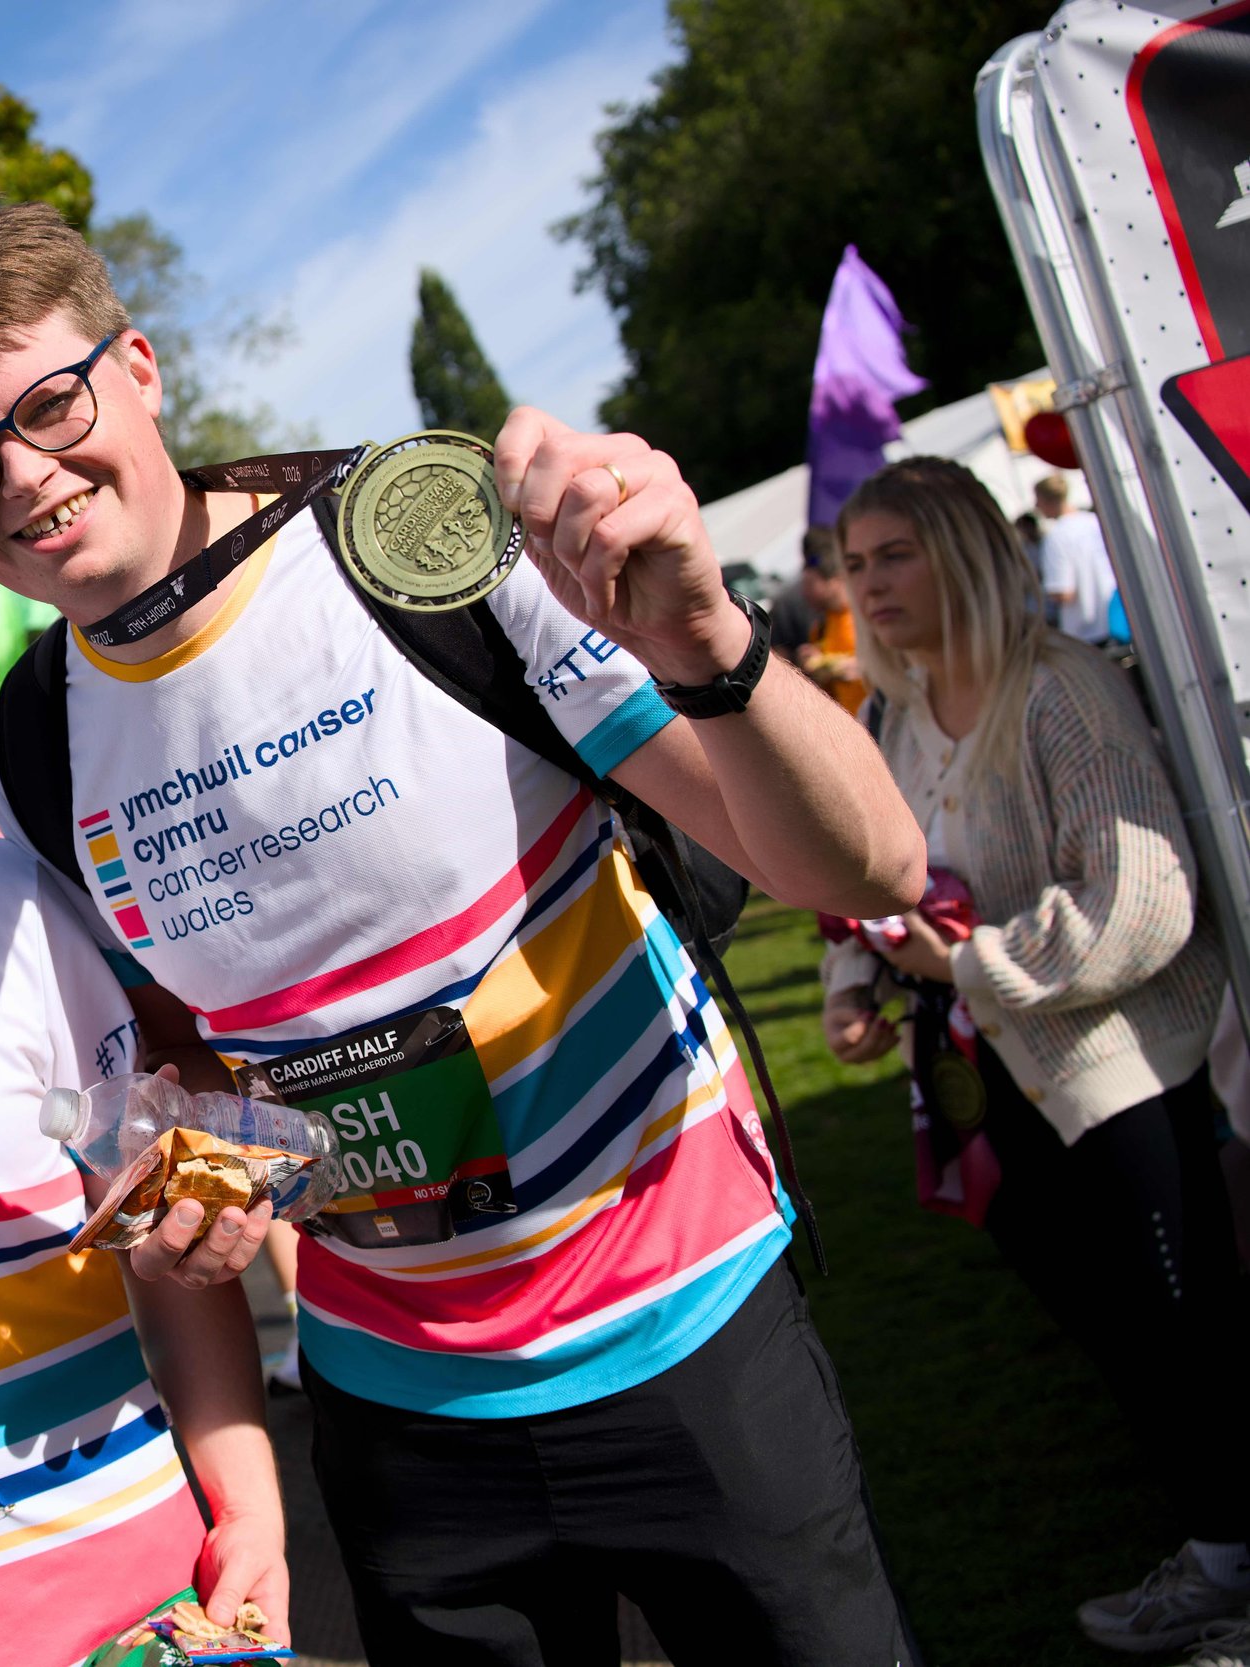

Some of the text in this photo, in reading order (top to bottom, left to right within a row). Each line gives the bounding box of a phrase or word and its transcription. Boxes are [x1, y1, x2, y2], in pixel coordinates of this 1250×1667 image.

[282, 466, 301, 482] 2026
[262, 502, 288, 532] 2026
[127, 596, 176, 636] CARDIFF HALF
[119, 688, 376, 832] ymchwil canser
[133, 807, 229, 866] cymru
[148, 776, 400, 902] cancer research
[162, 890, 254, 941] wales
[270, 1030, 399, 1084] CARDIFF HALF
[277, 1051, 405, 1096] HANNER MARATHON CAERDYDD
[331, 1091, 401, 1141] SH
[336, 1139, 427, 1193] 040
[414, 1187, 428, 1200] NO
